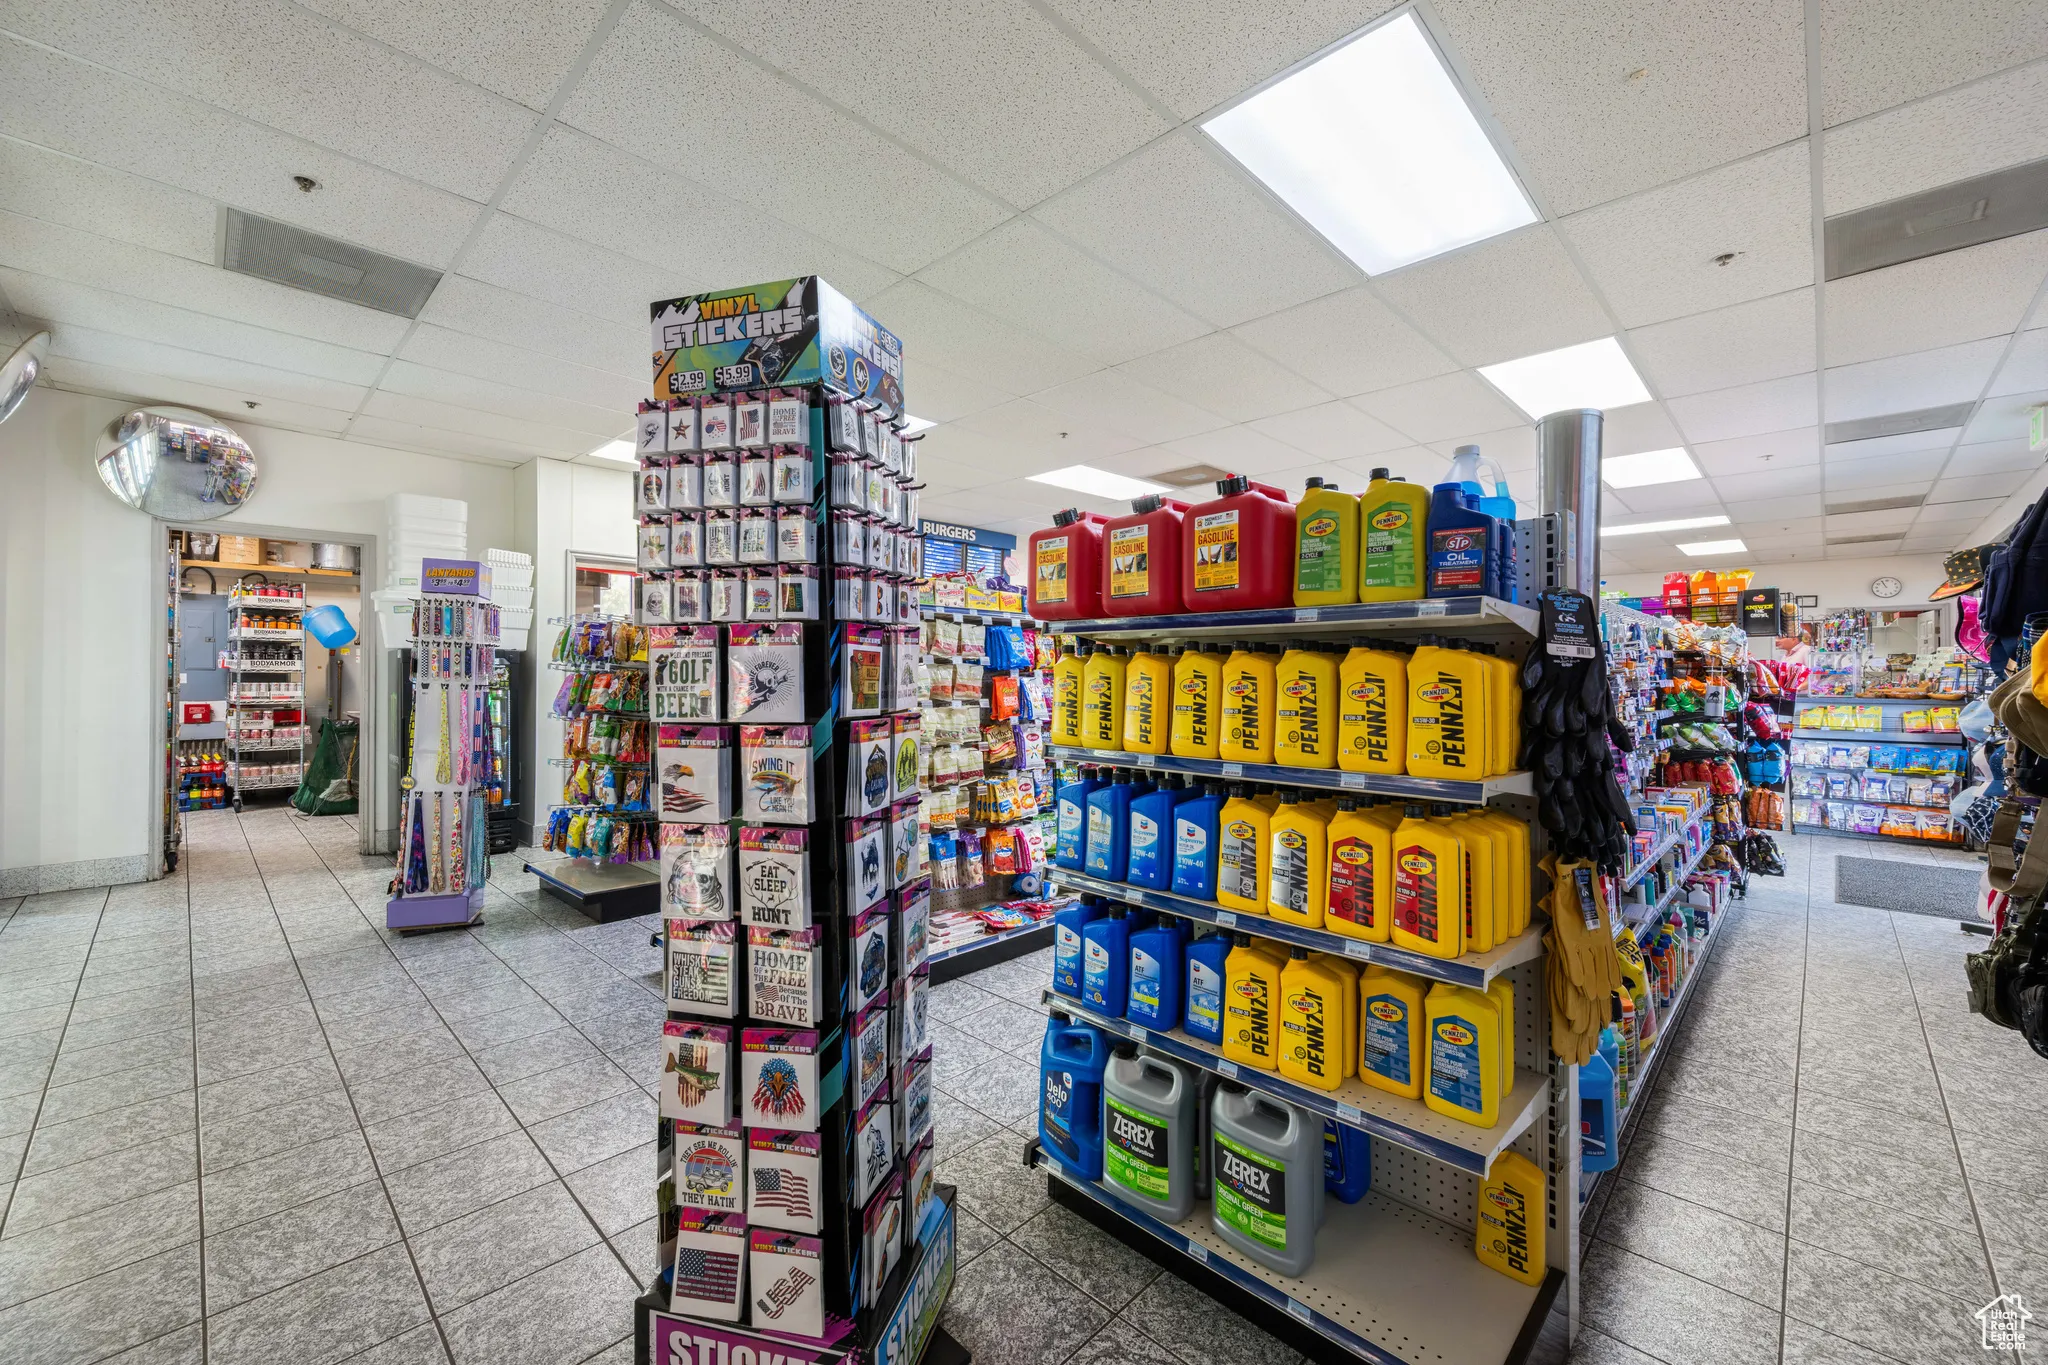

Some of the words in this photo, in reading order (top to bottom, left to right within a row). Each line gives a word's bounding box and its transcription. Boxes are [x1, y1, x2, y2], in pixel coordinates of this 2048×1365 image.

[700, 293, 759, 320] VINYL
[664, 306, 803, 351] STICKERS
[670, 371, 705, 392] $2.99
[714, 365, 751, 387] $5.99
[724, 378, 751, 386] LARGE
[773, 408, 797, 416] HOME
[1204, 514, 1224, 522] MIDWEST
[1376, 514, 1403, 527] PENNZOIL
[923, 520, 976, 541] BURGERS
[1309, 522, 1333, 534] PENNZOIL
[1197, 529, 1236, 546] GASOLINE
[1448, 537, 1469, 550] STP
[1113, 541, 1146, 557] GASOLINE
[1368, 546, 1388, 555] 2-CYCLE
[1038, 552, 1065, 565] GASOLINE
[1447, 552, 1470, 561] OIL
[1438, 559, 1478, 567] TREATMENT
[426, 566, 476, 579] LANYARDS
[1744, 603, 1774, 611] ANSWER
[669, 659, 713, 685] GOLF
[754, 661, 780, 673] FOREVER
[1182, 682, 1201, 690] PENNZOIL
[1230, 684, 1250, 692] PENNZOIL
[1351, 687, 1377, 696] PENNZOIL
[1421, 688, 1450, 697] PENNZOIL
[655, 693, 699, 718] BEER
[752, 758, 783, 774] SWING
[786, 760, 796, 774] IT
[1132, 828, 1157, 838] Supreme
[1178, 835, 1205, 846] Supreme
[763, 842, 800, 852] STICKERS
[1340, 850, 1365, 860] PENNZOIL
[1181, 857, 1204, 869] 10W-40
[1333, 861, 1343, 869] HIGH
[1404, 860, 1429, 870] PENNZOIL
[760, 865, 778, 878] EAT
[1333, 866, 1350, 875] MILEAGE
[1397, 871, 1407, 879] HIGH
[754, 877, 788, 893] SLEEP
[1397, 876, 1413, 886] MILEAGE
[752, 905, 791, 926] HUNT
[753, 950, 807, 972] HOME
[673, 963, 700, 978] STEAK
[1134, 965, 1145, 974] ATF
[673, 975, 696, 989] GUNS
[754, 973, 769, 983] THE
[770, 969, 807, 989] FREE
[1193, 977, 1204, 987] ATF
[673, 987, 713, 1003] FREEDOM
[778, 986, 807, 997] Because
[1236, 985, 1259, 994] PENNZOIL
[790, 994, 808, 1006] The
[1291, 999, 1315, 1009] PENNZOIL
[754, 1000, 808, 1023] BRAVE
[1373, 1006, 1398, 1016] PENNZOIL
[1366, 1016, 1389, 1028] AUTOMATIC
[1366, 1026, 1378, 1035] FLUID
[1441, 1029, 1468, 1040] PENNZOIL
[745, 1043, 769, 1051] VINYL
[769, 1044, 812, 1054] STICKERS
[1433, 1040, 1458, 1051] AUTOMATIC
[1433, 1045, 1467, 1059] TRANSMISSION
[1433, 1050, 1446, 1059] FLUID
[1449, 1060, 1462, 1069] POUR
[1047, 1076, 1067, 1103] Delo
[1046, 1092, 1062, 1108] 400
[1113, 1111, 1155, 1151] ZEREX
[753, 1140, 777, 1149] VINYL
[776, 1142, 817, 1155] STICKERS
[1131, 1144, 1155, 1159] Valvoline
[680, 1148, 694, 1164] THEY
[693, 1141, 707, 1150] SEE
[707, 1140, 717, 1149] ME
[718, 1144, 739, 1169] ROLLIN'
[1108, 1144, 1129, 1165] ORIGINAL
[1129, 1157, 1149, 1173] GREEN
[1222, 1149, 1271, 1196] ZEREX
[682, 1191, 705, 1204] THEY
[707, 1194, 738, 1209] HATIN'
[1217, 1184, 1241, 1207] ORIGINAL
[1241, 1200, 1264, 1219] GREEN
[1243, 1186, 1270, 1205] Valvoline
[1489, 1192, 1514, 1205] PENNZOIL
[706, 1224, 744, 1236] STICKERS
[754, 1243, 777, 1252] VINYL
[777, 1245, 818, 1259] STICKERS
[756, 1265, 817, 1320] USA
